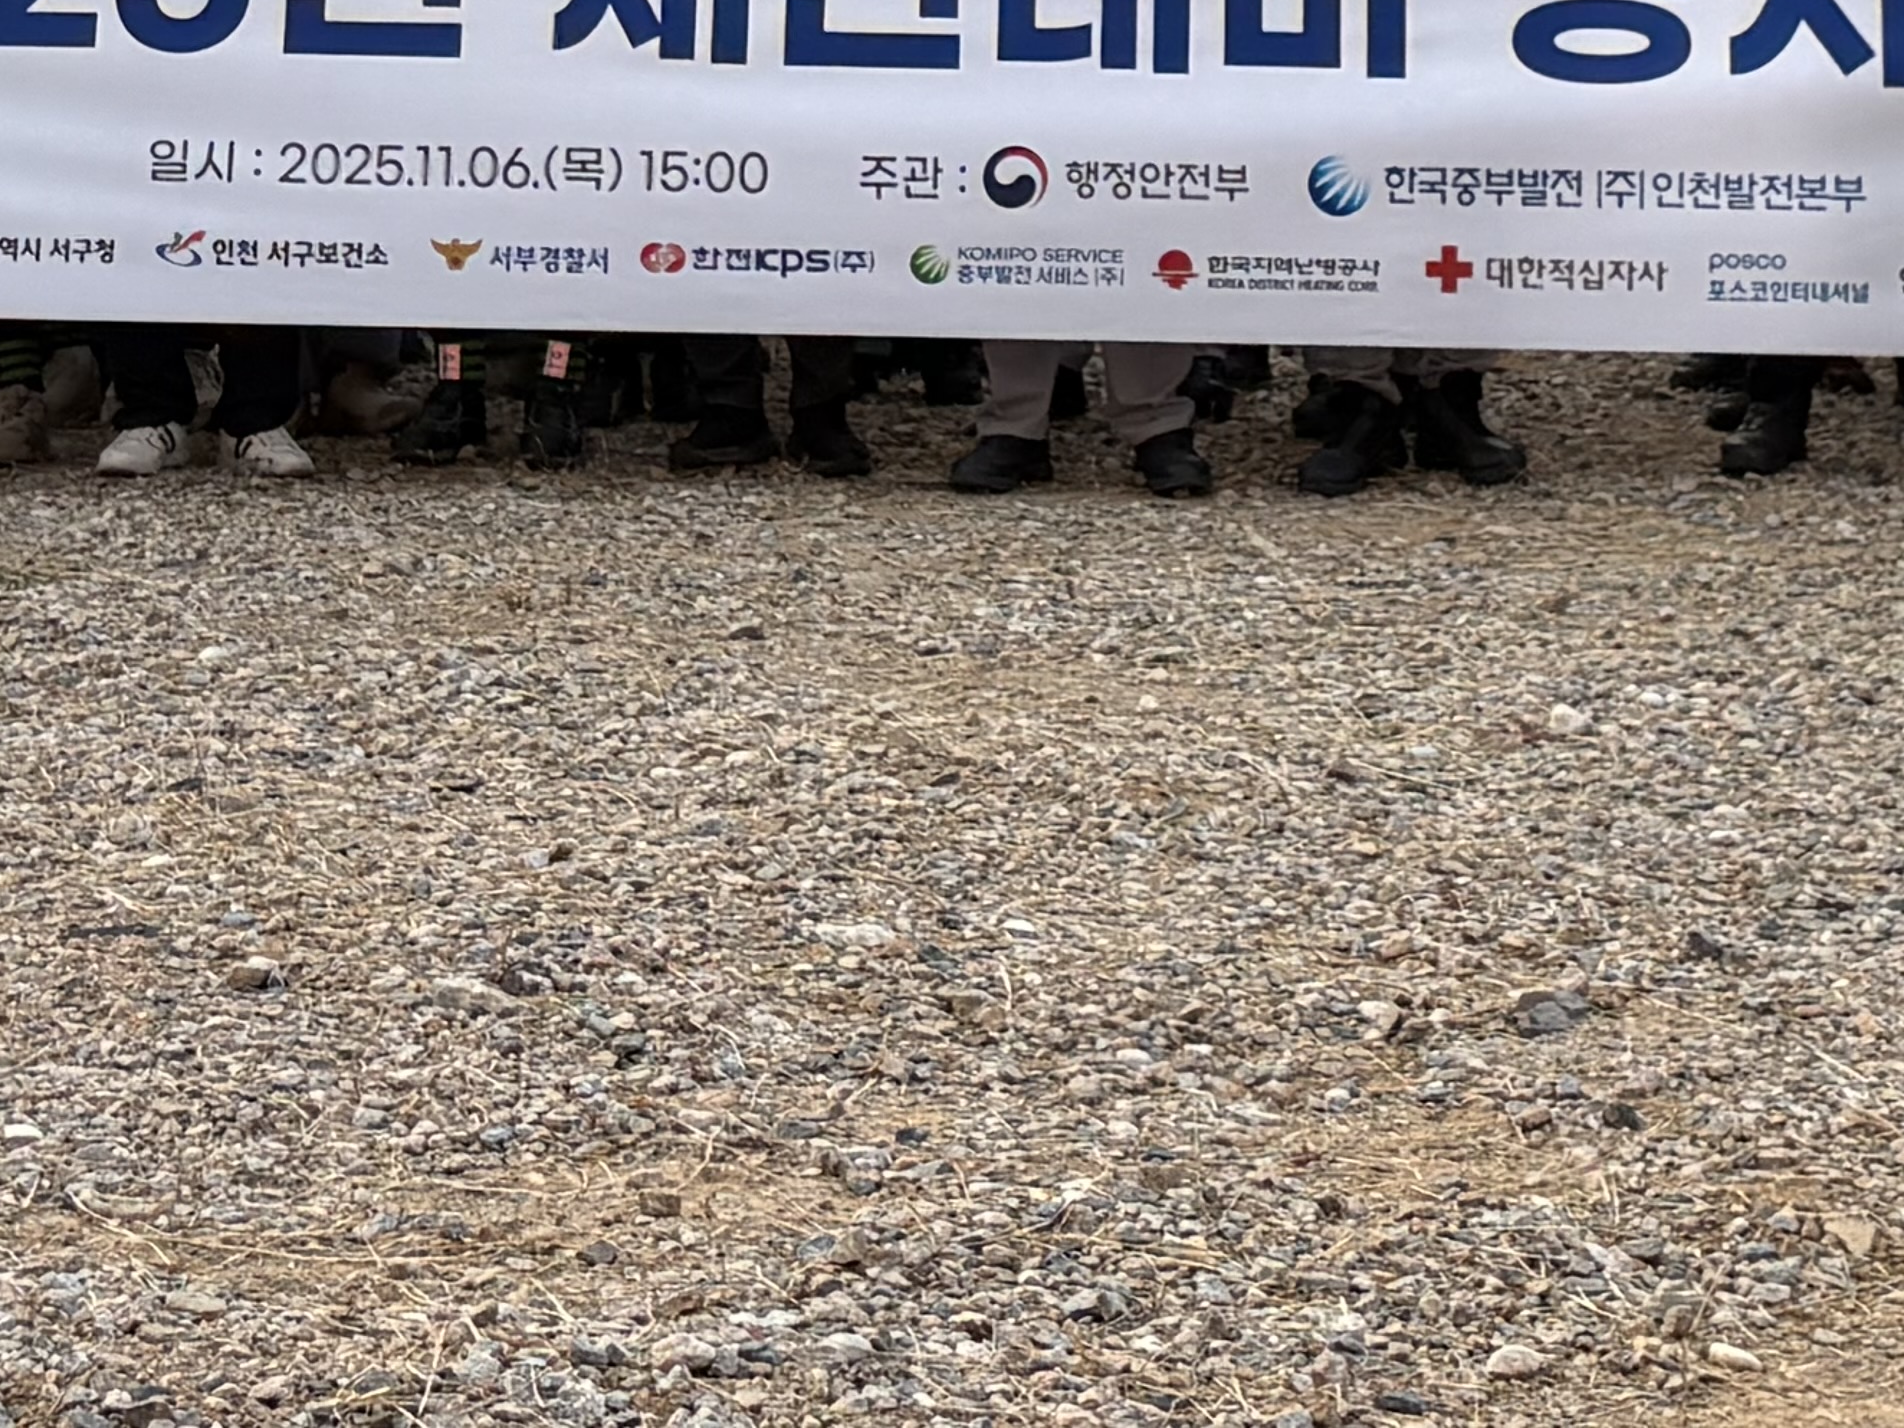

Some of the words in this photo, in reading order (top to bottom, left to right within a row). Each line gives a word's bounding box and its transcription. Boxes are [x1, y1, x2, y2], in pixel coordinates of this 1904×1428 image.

[149, 139, 235, 184] 일시
[278, 141, 623, 193] 2025.11.06.(목)
[640, 149, 769, 195] 15:00
[859, 155, 944, 201] 주관
[1064, 160, 1250, 203] 행정안전부
[1384, 165, 1583, 208] 한국중부발전
[49, 237, 115, 264] 서구청
[212, 239, 259, 267] 인천
[267, 240, 389, 269] 서구보건소
[489, 245, 609, 275] 서부경찰서
[957, 246, 1038, 263] KOMIPO
[1042, 247, 1124, 264] SERVICE
[1708, 252, 1787, 274] posco
[1485, 255, 1669, 292] 대한적십자사
